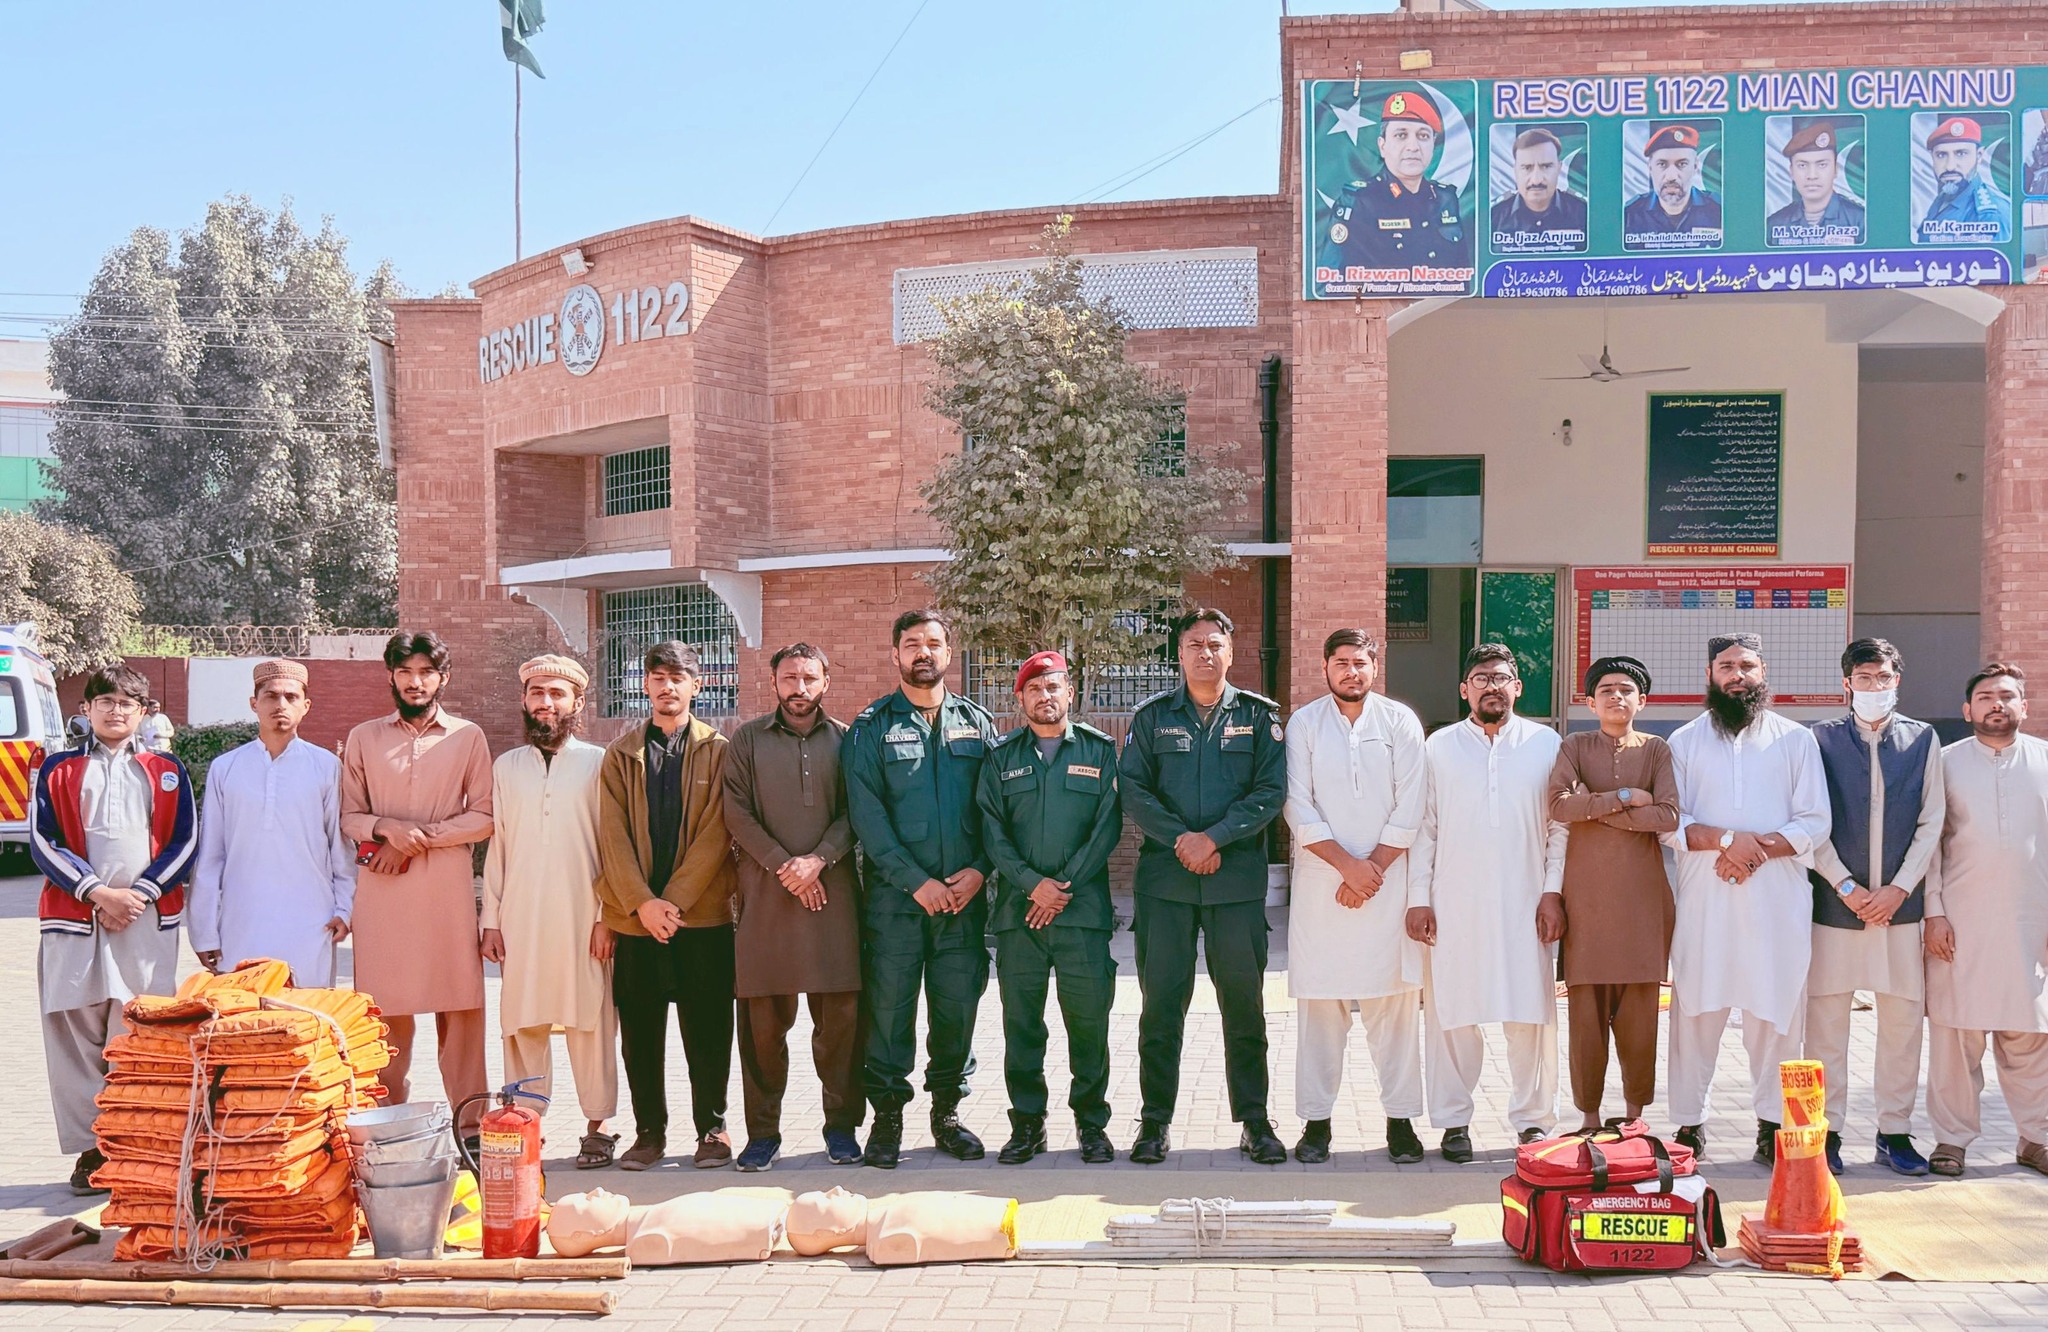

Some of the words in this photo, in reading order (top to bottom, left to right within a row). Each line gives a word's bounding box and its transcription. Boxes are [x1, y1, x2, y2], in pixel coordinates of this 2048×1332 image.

[1495, 79, 1646, 117] RESCUE
[1655, 76, 1728, 113] 1122
[1739, 73, 1837, 110] MIAN
[1849, 70, 2014, 107] CHANNU
[1773, 226, 1789, 237] M.
[1791, 225, 1825, 237] Yasir
[1827, 225, 1859, 236] Raza
[1943, 220, 1999, 232] Kamran
[1494, 232, 1513, 243] Dr.
[1515, 231, 1537, 246] Ijaz
[1541, 231, 1584, 245] Anjum
[1626, 234, 1640, 243] Dr.
[1673, 232, 1719, 241] Mehmood
[1317, 267, 1343, 282] Dr.
[1346, 267, 1410, 282] Rizwan
[1413, 266, 1474, 281] Naseer
[1498, 287, 1568, 297] 0321-9630786
[1577, 285, 1647, 296] 0304-7600786
[479, 312, 557, 384] RESCUE
[611, 281, 690, 346] 1122
[1649, 545, 1685, 553] RESCUE
[1688, 545, 1709, 553] 1122
[1711, 545, 1734, 553] MIAN
[1736, 545, 1775, 553] CHANNU
[1592, 1197, 1649, 1209] EMERGENCY
[1651, 1198, 1671, 1209] BAG
[1601, 1218, 1669, 1236] RESCUE
[1610, 1248, 1655, 1263] 1122
